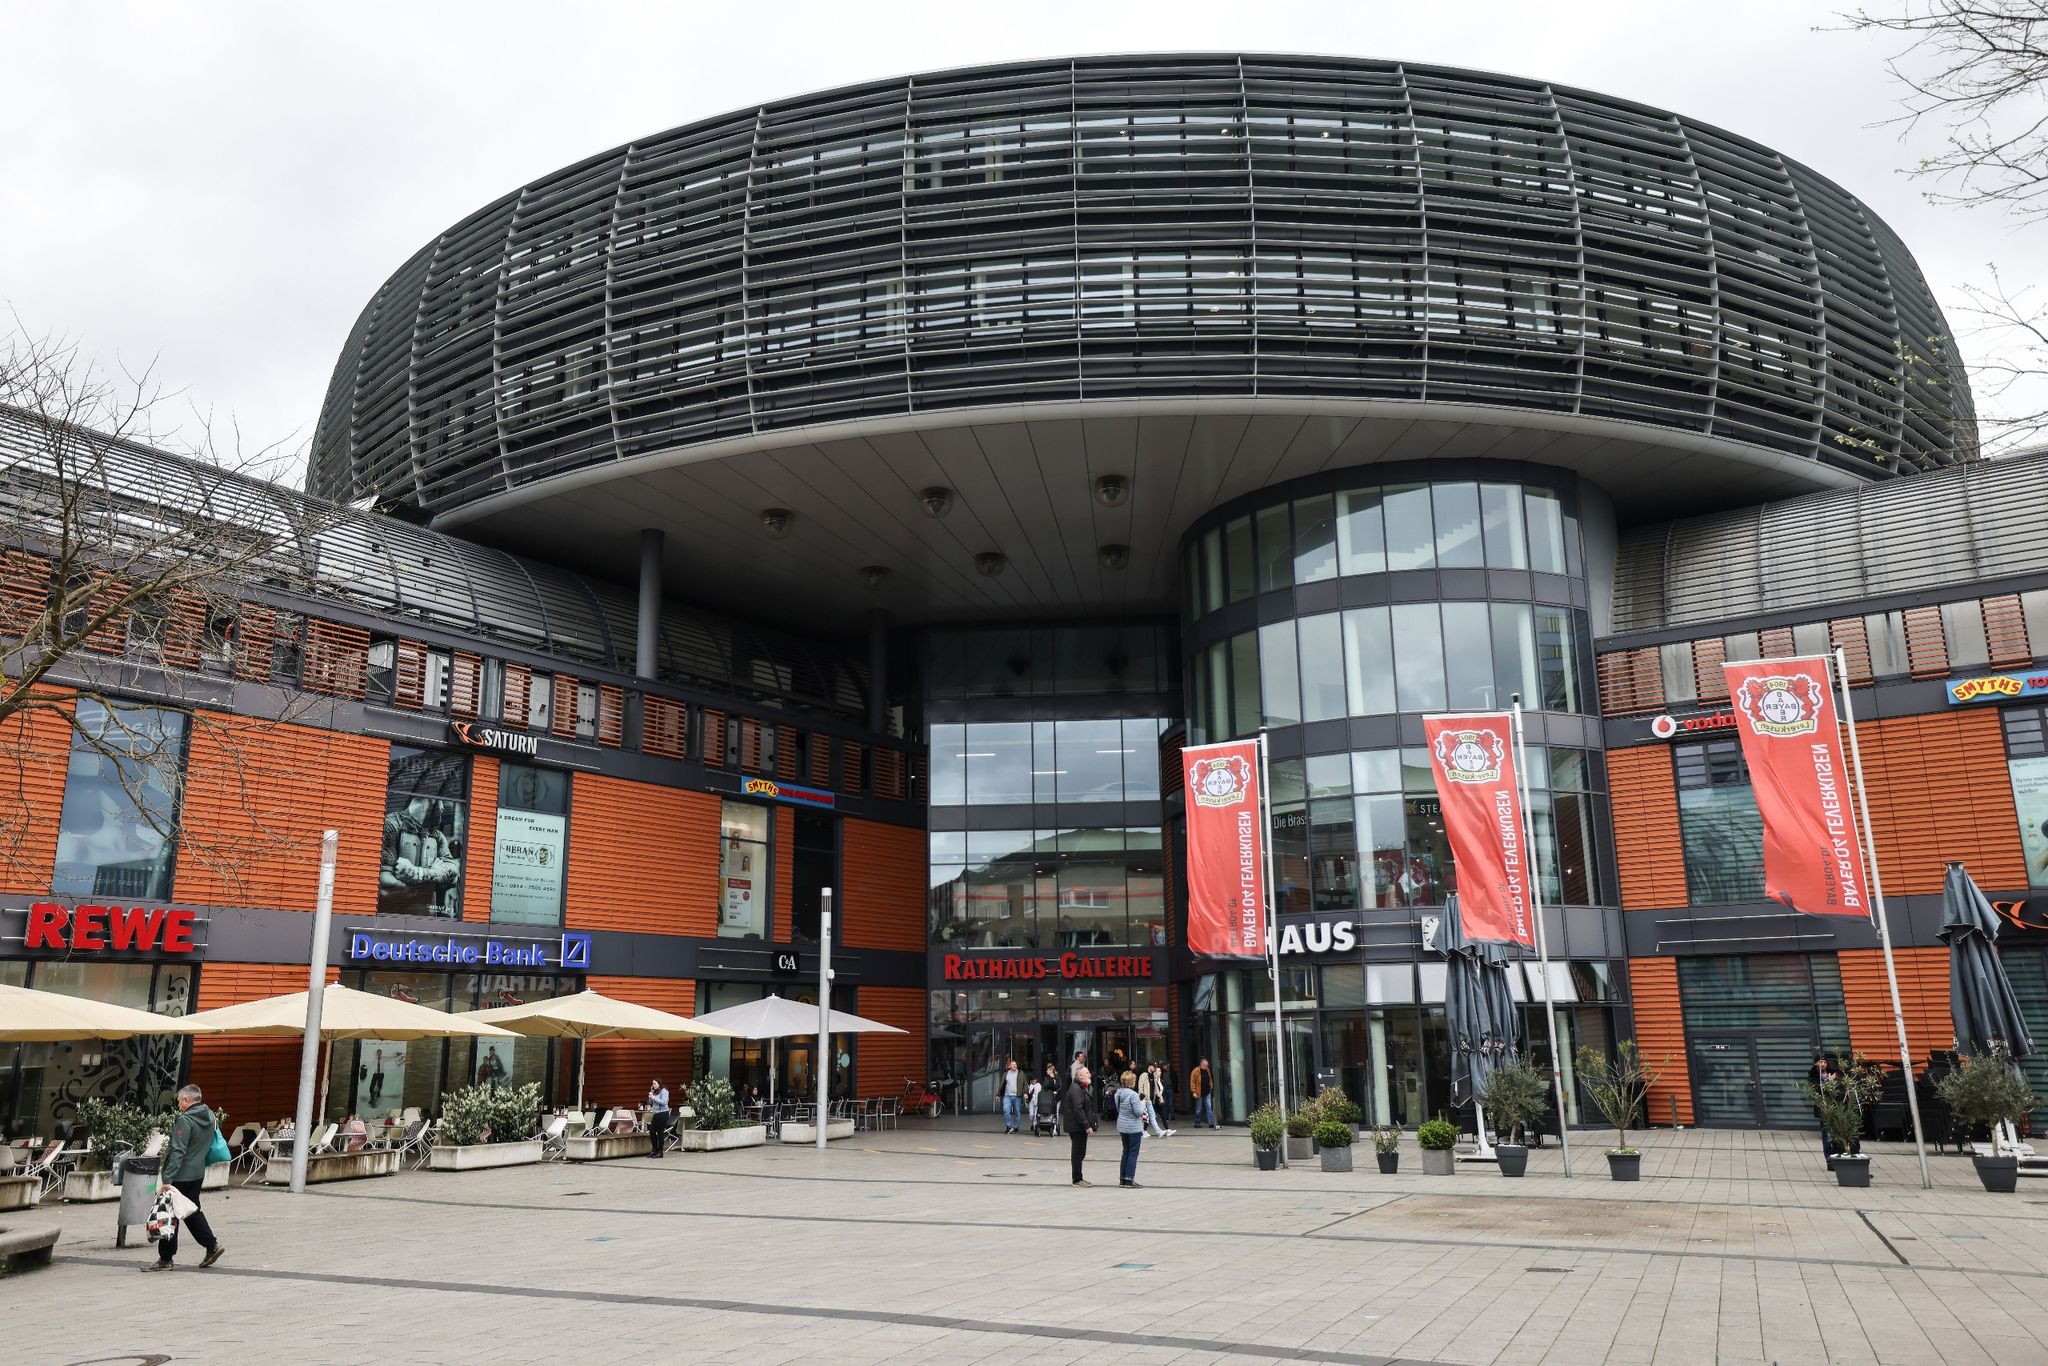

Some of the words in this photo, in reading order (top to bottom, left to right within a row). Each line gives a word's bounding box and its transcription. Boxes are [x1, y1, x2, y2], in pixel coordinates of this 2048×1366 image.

[1954, 678, 2021, 699] SMYTHS
[2027, 675, 2048, 689] TO
[482, 728, 538, 754] SATURN
[748, 780, 778, 796] SMYTHS
[1273, 815, 1287, 829] Die
[25, 902, 196, 953] REWE
[351, 933, 479, 965] Deutsche
[486, 941, 548, 966] Bank
[778, 954, 797, 970] C&A
